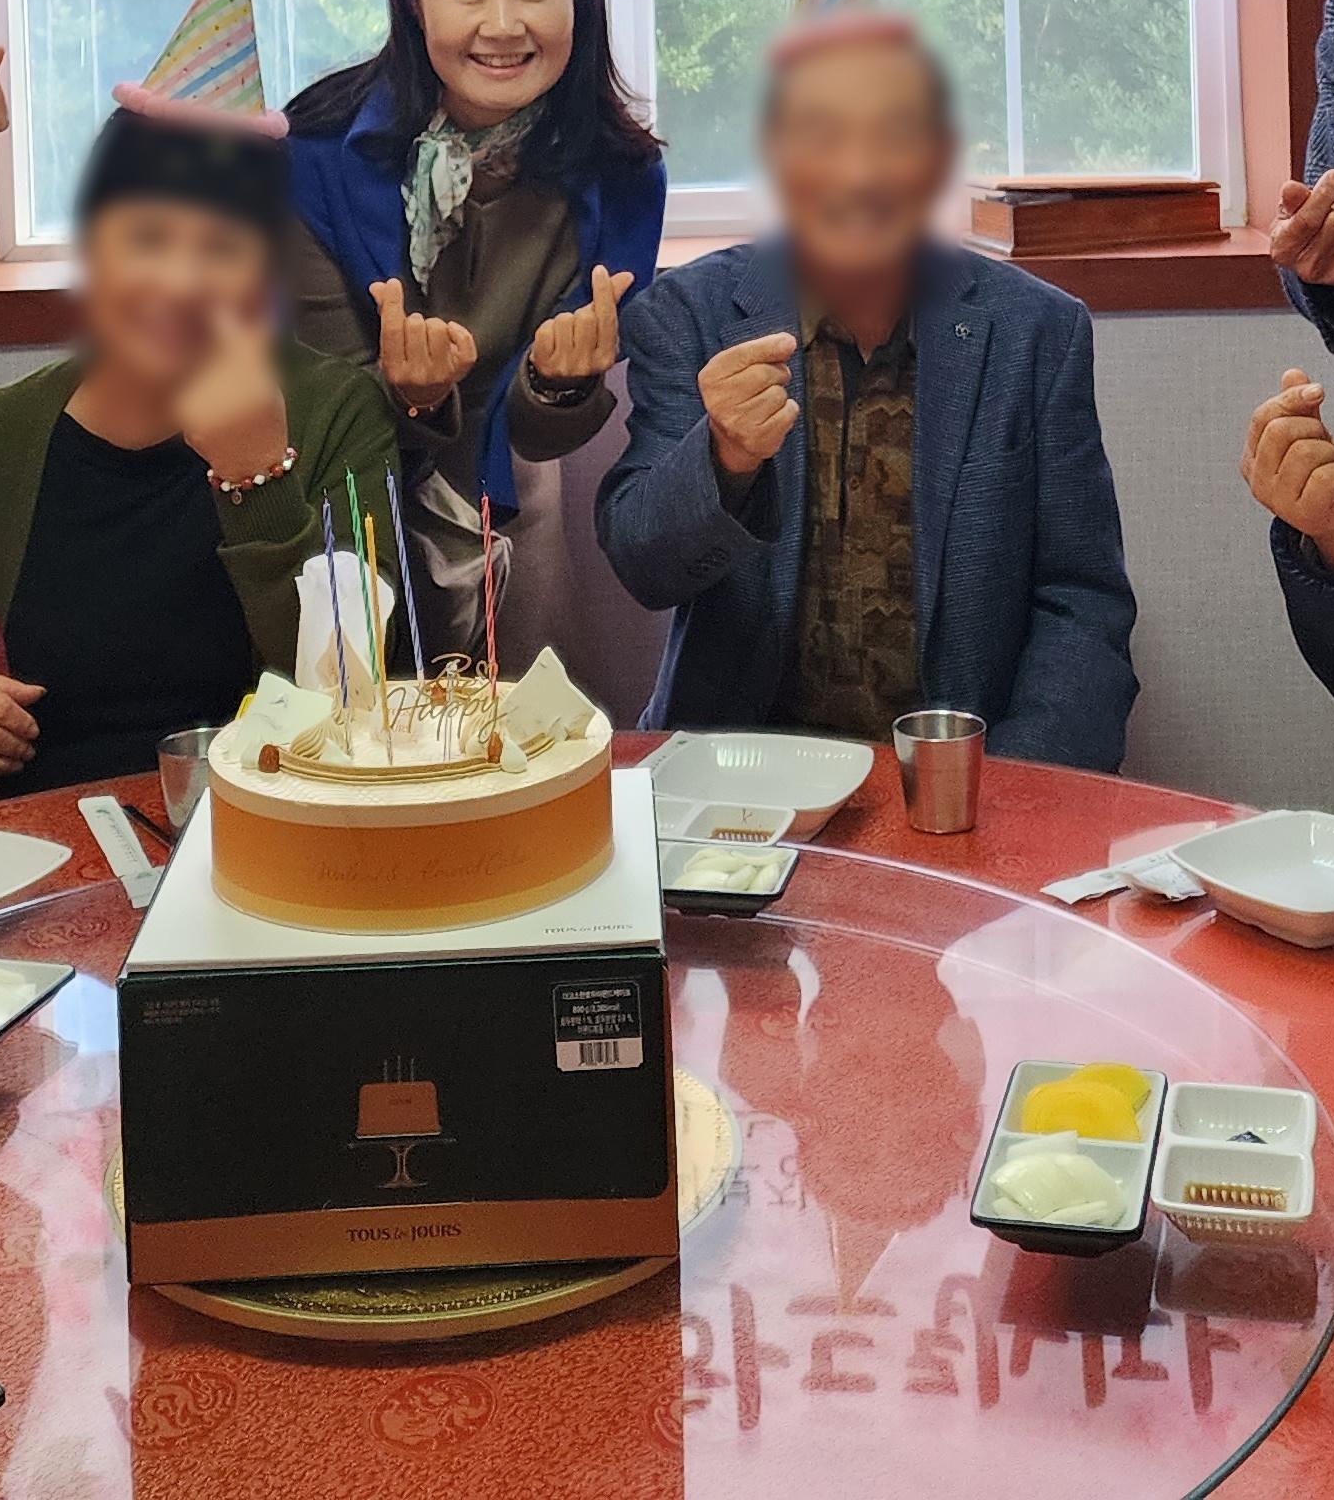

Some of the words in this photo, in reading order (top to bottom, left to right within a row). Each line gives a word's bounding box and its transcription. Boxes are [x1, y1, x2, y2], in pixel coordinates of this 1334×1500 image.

[386, 686, 508, 745] Happy
[346, 1227, 391, 1242] TOUS
[410, 1223, 462, 1241] JOURS
